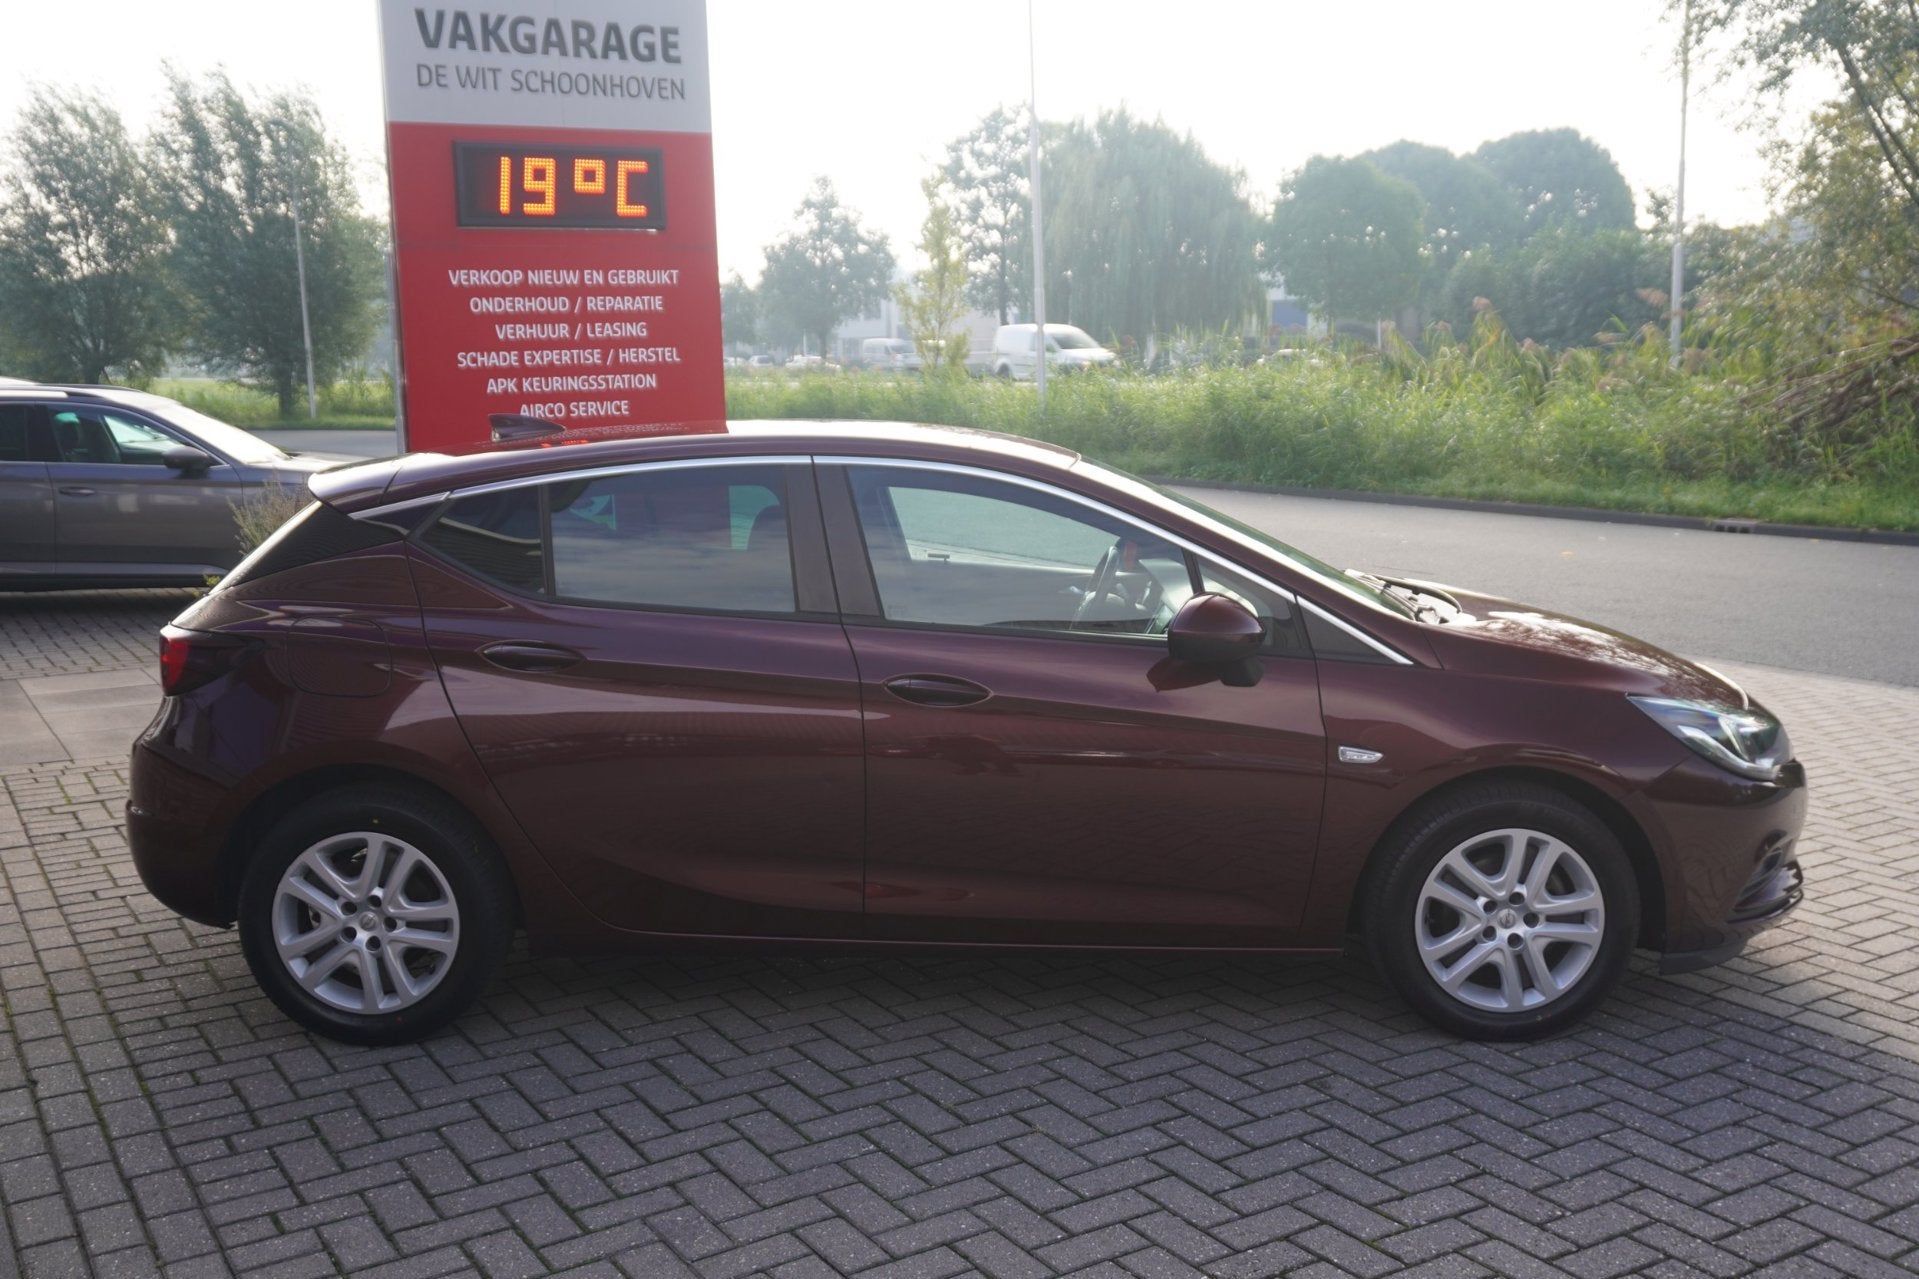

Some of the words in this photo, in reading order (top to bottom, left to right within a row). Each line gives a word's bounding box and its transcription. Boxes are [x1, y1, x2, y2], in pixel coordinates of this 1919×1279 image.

[414, 8, 682, 64] VAKGARAGE
[416, 63, 449, 88] DE
[454, 65, 502, 91] WIT
[510, 69, 686, 101] SCHOONHOVEN
[499, 156, 556, 216] 19
[448, 269, 523, 286] VERKOOP
[527, 269, 579, 285] NIEUW
[583, 269, 604, 285] EN
[607, 270, 680, 284] GEBRUIKT
[469, 296, 570, 313] ONDERHOUD
[586, 295, 664, 311] REPARATIE
[495, 323, 570, 340] VERHUUR
[586, 321, 648, 337] LEASING
[456, 351, 519, 368] SCHADE
[523, 348, 602, 366] EXPERTISE
[618, 346, 681, 363] HERSTEL
[486, 378, 518, 394] APK
[521, 373, 657, 392] KEURINGSSTATION
[519, 402, 566, 418] AIRCO
[569, 399, 630, 416] SERVICE
